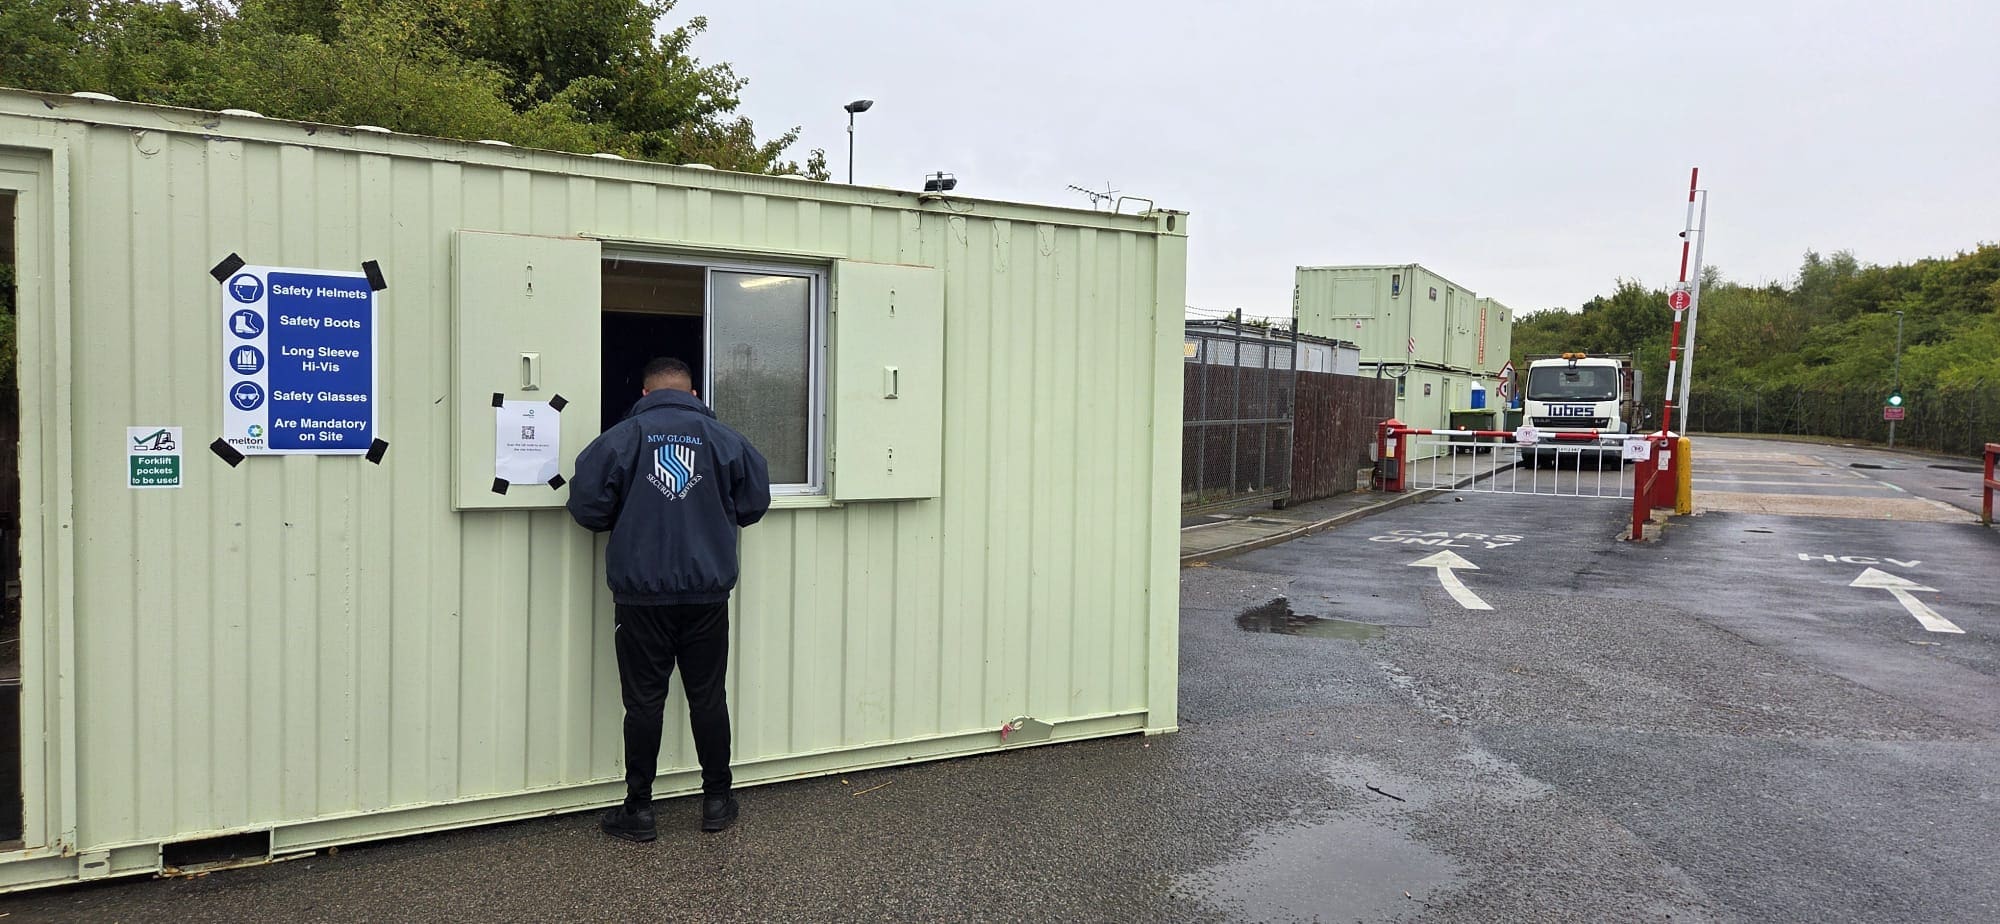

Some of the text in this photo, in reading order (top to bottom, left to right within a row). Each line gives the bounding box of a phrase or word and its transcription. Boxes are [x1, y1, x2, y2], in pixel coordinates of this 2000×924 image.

[272, 284, 368, 300] Safety Helmets
[1675, 291, 1684, 309] STOP
[279, 314, 361, 329] Safety Boots
[281, 345, 360, 359] Long Sleeve
[302, 361, 340, 372] Hi-Vis
[273, 390, 368, 404] Safety Glasses
[1543, 403, 1596, 417] Tubes
[274, 418, 367, 431] Are Mandatory
[228, 437, 264, 445] melton
[299, 431, 344, 441] on Site
[647, 434, 703, 446] MW GLOBAL
[138, 457, 172, 465] Forklift
[136, 467, 173, 476] pockets
[156, 476, 178, 484] used
[646, 473, 703, 501] SECURITY SERVICES
[1368, 535, 1515, 549] ONLY
[1388, 529, 1525, 542] CARS
